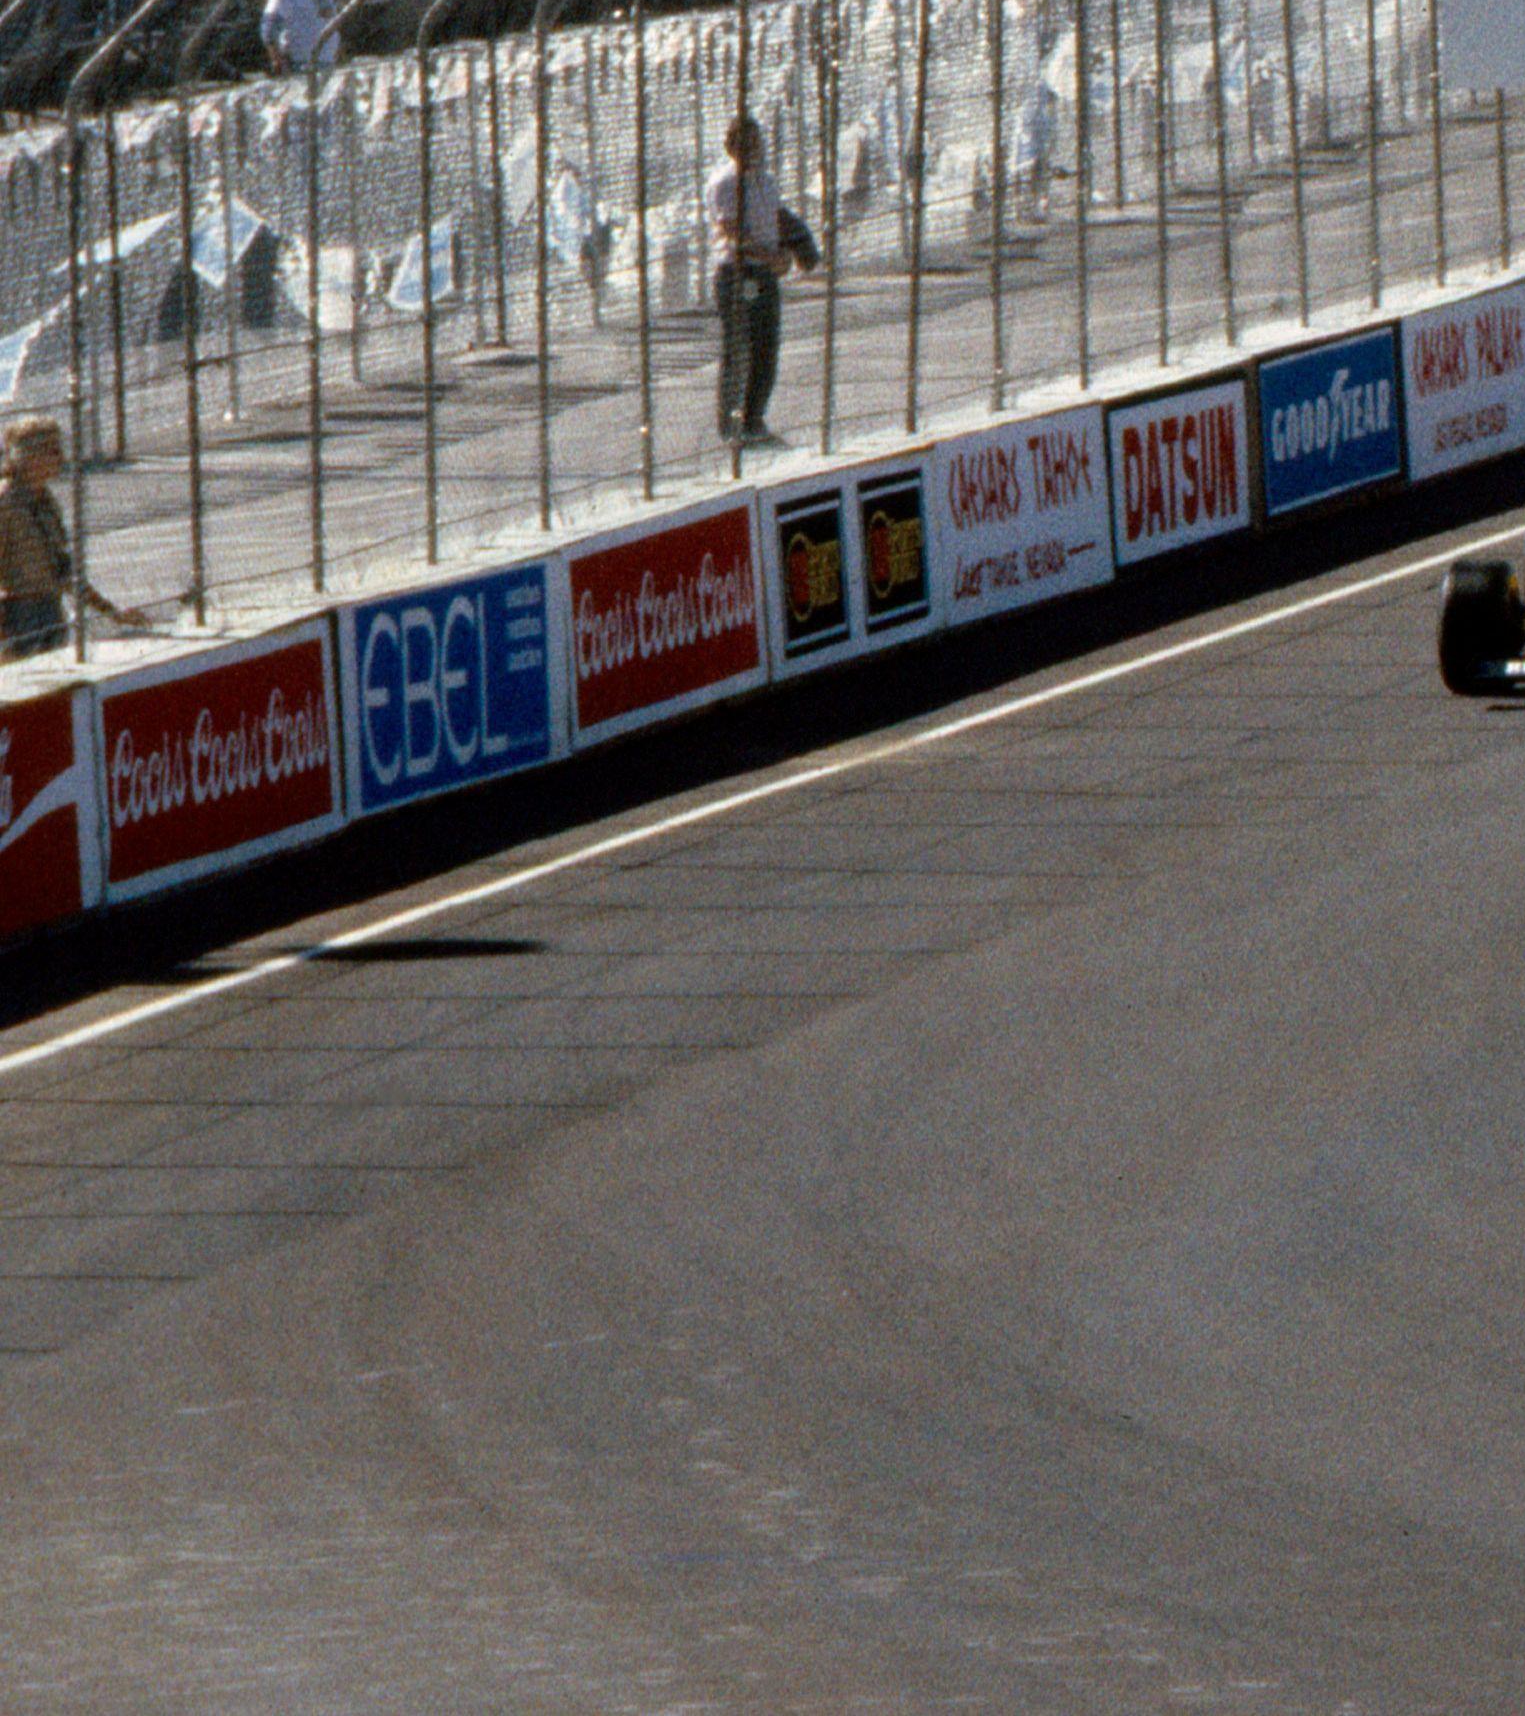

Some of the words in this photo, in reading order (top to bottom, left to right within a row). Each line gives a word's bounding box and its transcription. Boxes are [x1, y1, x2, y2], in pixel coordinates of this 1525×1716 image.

[1122, 403, 1238, 543] DATSUN
[1271, 369, 1390, 462] GOODYEAR
[361, 593, 508, 785] EBEL
